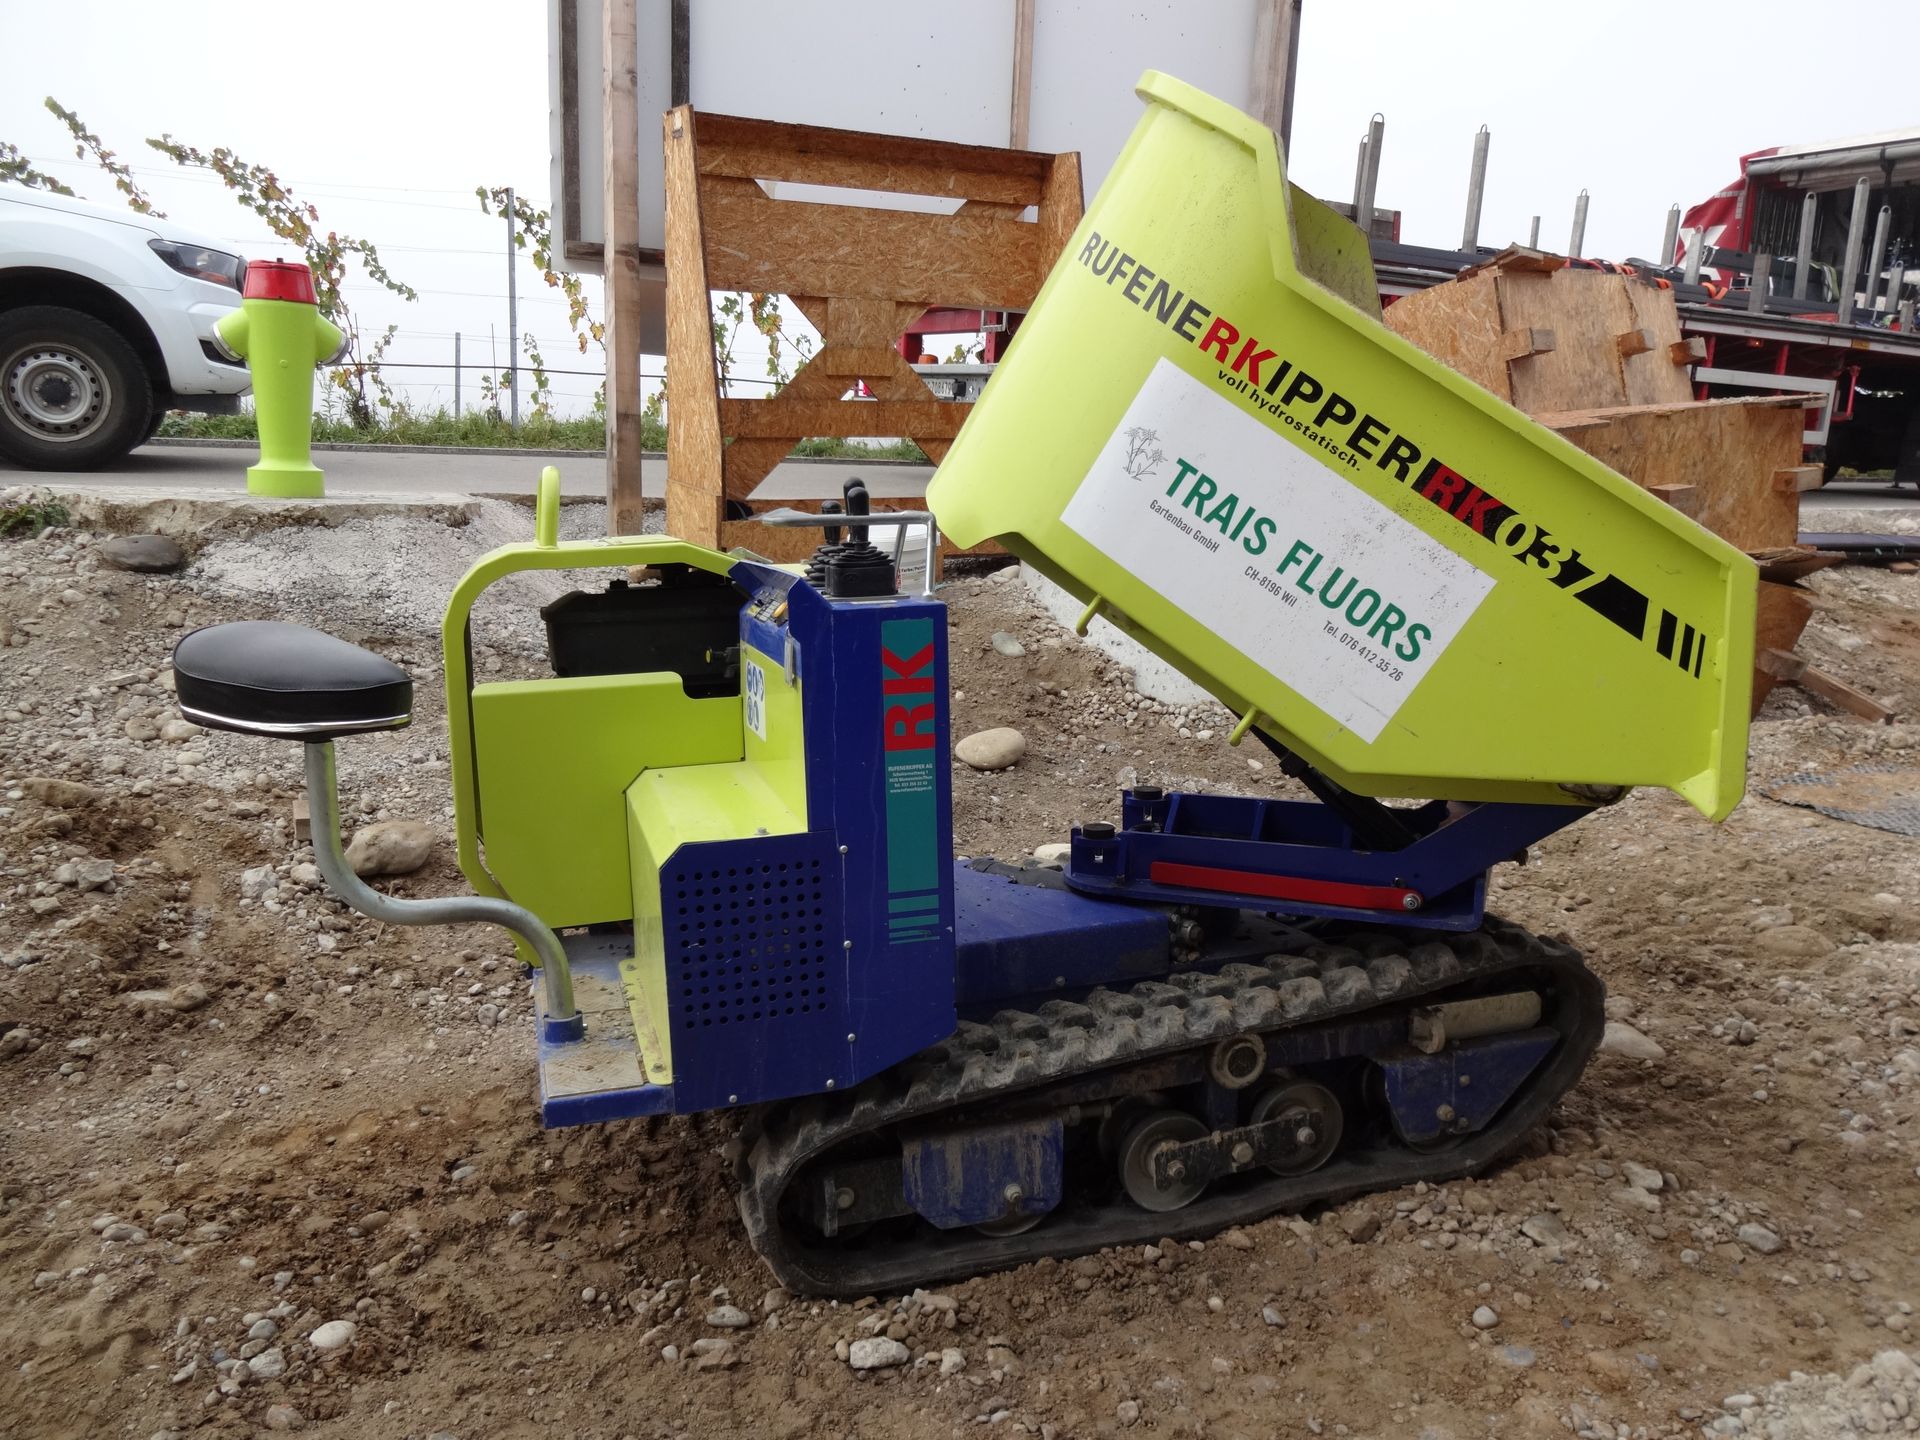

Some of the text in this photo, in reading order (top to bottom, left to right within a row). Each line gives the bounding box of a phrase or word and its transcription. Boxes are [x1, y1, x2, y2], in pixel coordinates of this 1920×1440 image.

[1078, 231, 1422, 483] RUFENERKIPPER
[1217, 369, 1361, 472] voll hydrostatisch.
[1149, 499, 1220, 553] Gartenbau GmbH
[1165, 457, 1432, 663] TRAIS FLUORS
[1244, 565, 1298, 608] CH-8196 Wil
[881, 641, 936, 753] RK
[1322, 619, 1404, 682] Tel. 076 412 35 26
